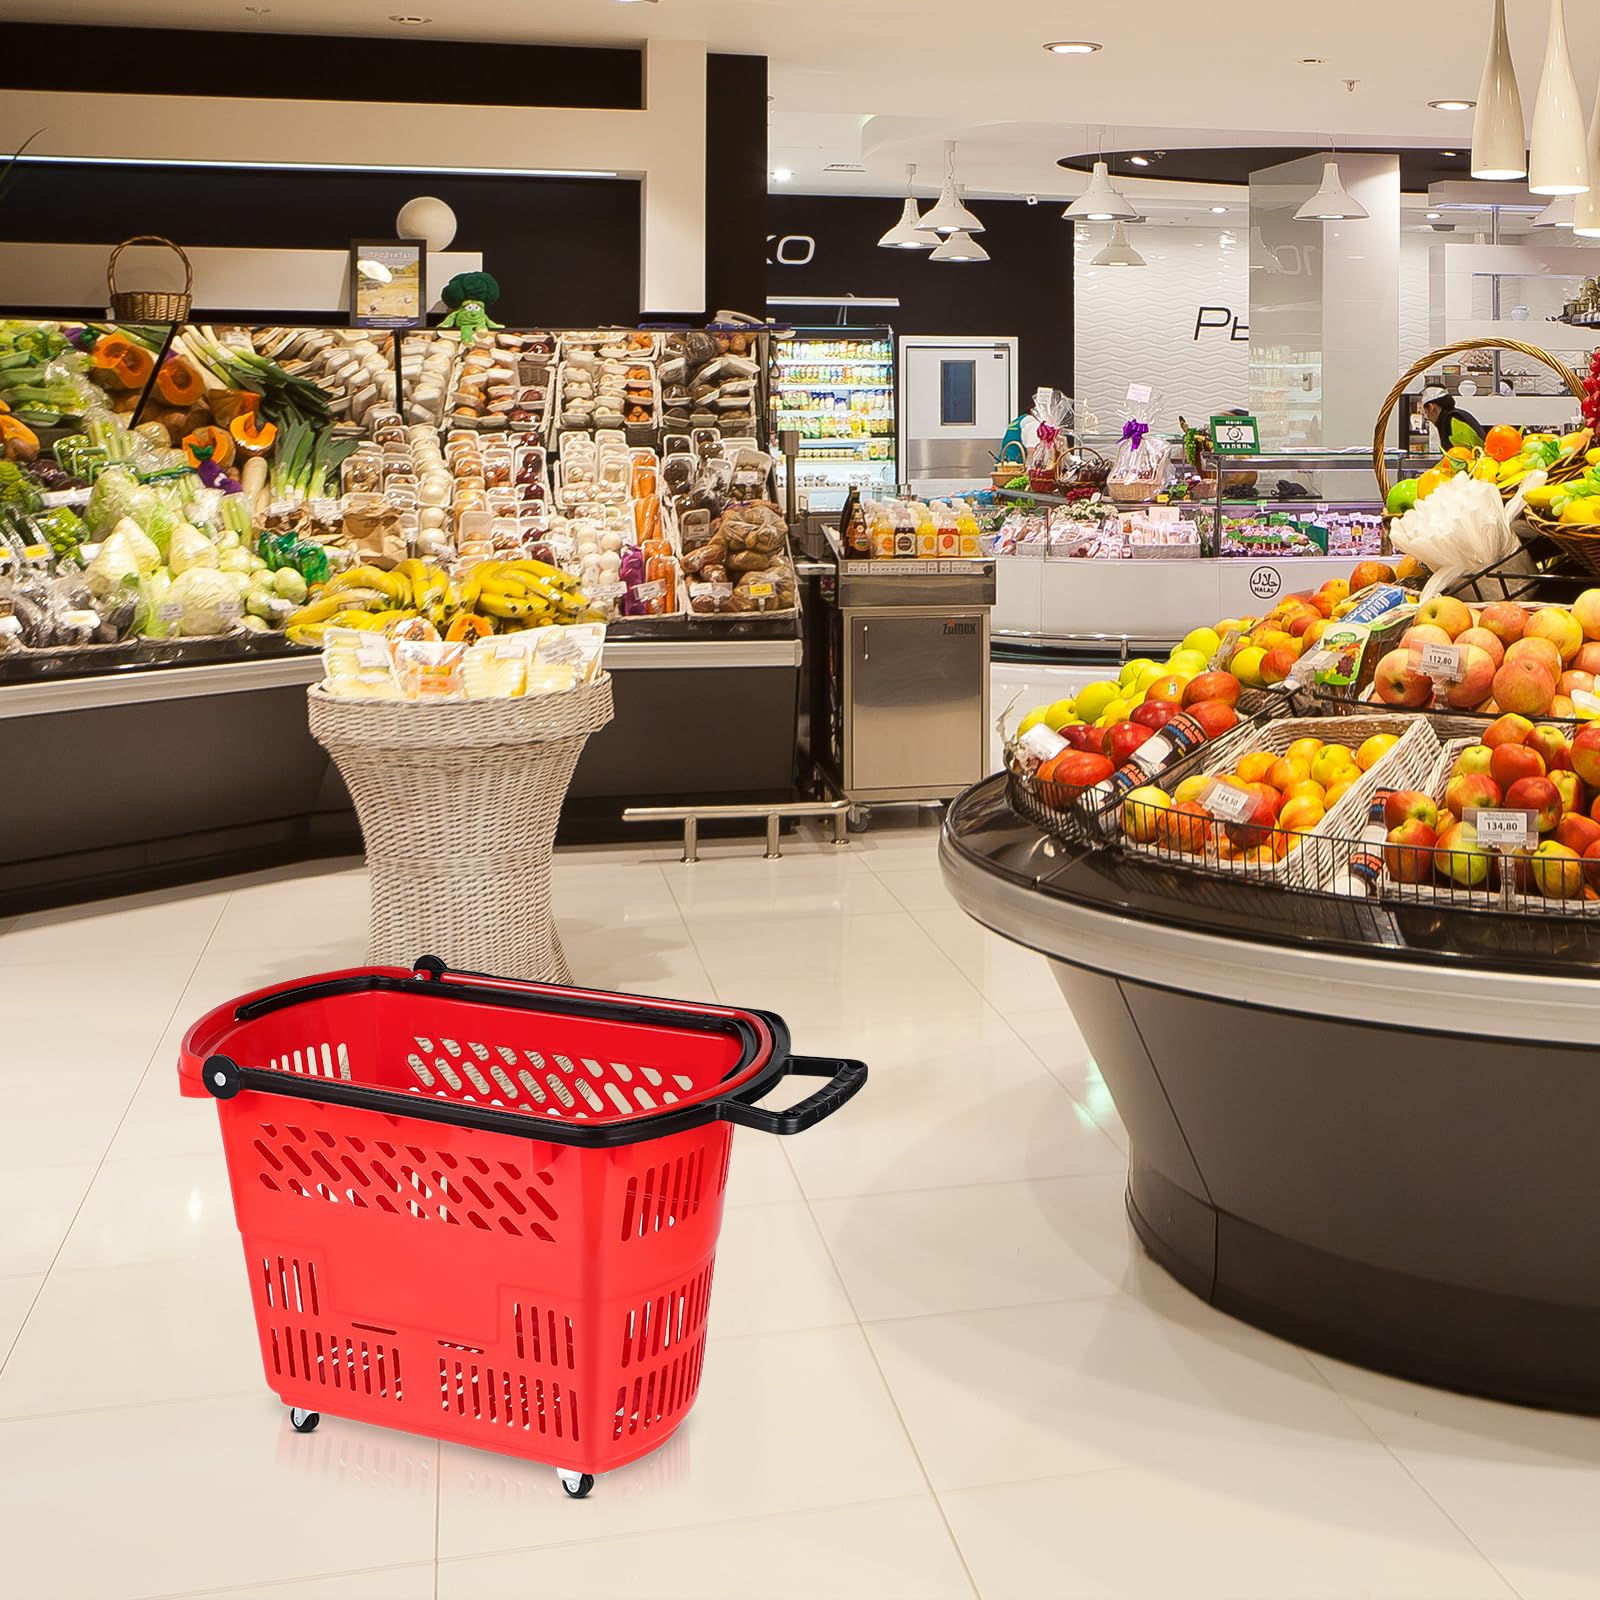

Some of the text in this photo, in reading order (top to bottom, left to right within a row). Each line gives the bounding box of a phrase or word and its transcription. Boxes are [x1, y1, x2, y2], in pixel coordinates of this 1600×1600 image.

[1254, 586, 1275, 594] HALAL
[1429, 655, 1453, 666] 112,80
[1487, 821, 1518, 832] 134,80
